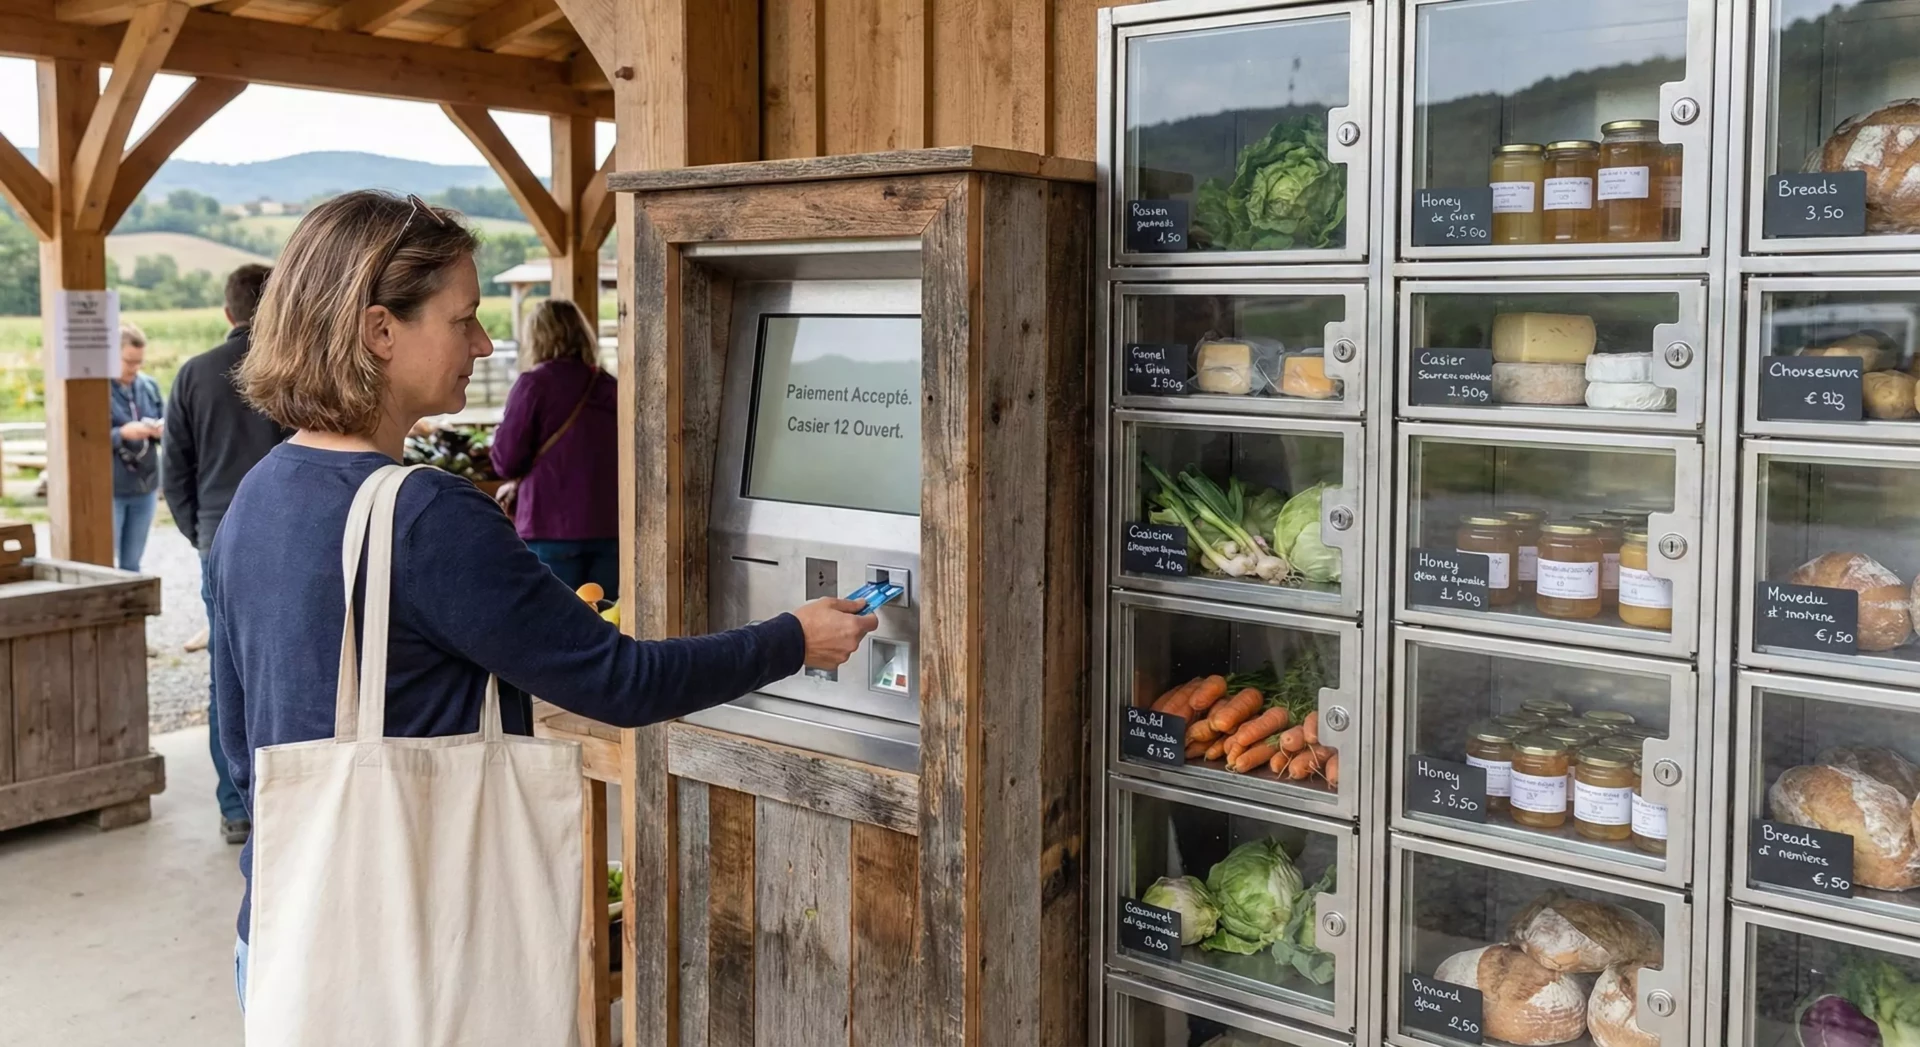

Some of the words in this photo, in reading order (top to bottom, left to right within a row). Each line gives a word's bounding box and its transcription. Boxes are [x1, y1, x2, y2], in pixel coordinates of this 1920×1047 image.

[1779, 179, 1837, 197] Breads
[1422, 193, 1461, 212] Honey
[1805, 205, 1843, 221] 3,50
[1420, 352, 1465, 365] Casier
[786, 384, 848, 402] Paiement
[851, 387, 912, 408] Accepté.
[787, 416, 830, 434] Casier
[834, 419, 849, 435] 12
[853, 420, 903, 439] Ouvert.
[1420, 553, 1459, 574] Honey
[1418, 761, 1459, 790] Honey
[1762, 824, 1821, 848] Breads
